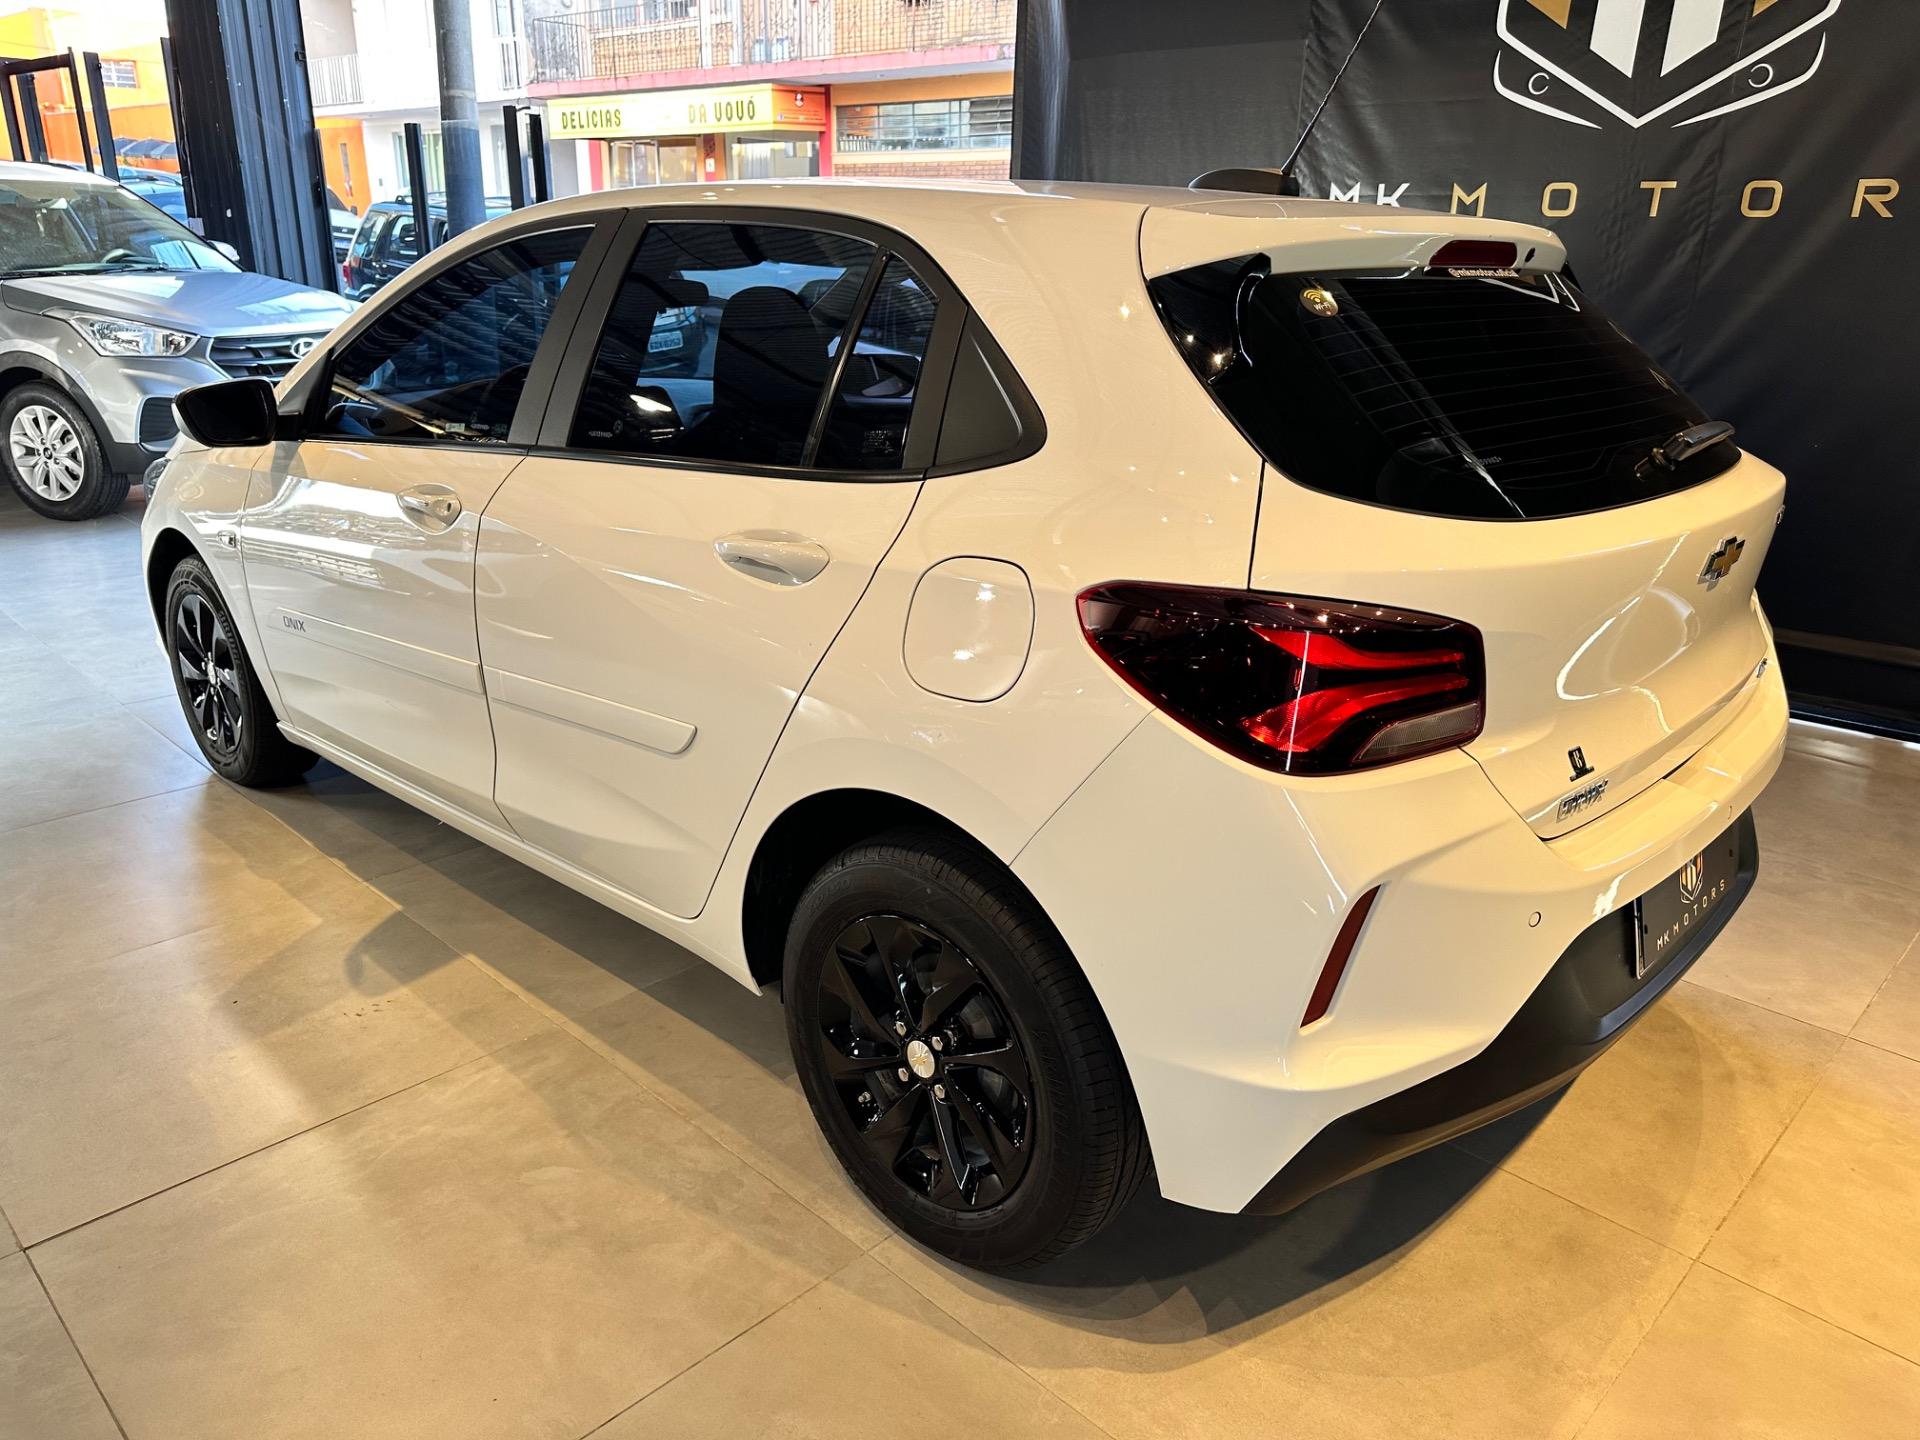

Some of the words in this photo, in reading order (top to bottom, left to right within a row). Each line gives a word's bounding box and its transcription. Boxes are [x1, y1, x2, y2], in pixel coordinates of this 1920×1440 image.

[1329, 181, 1411, 208] MK
[282, 615, 307, 633] ONIX
[1672, 879, 1726, 936] MOTORS
